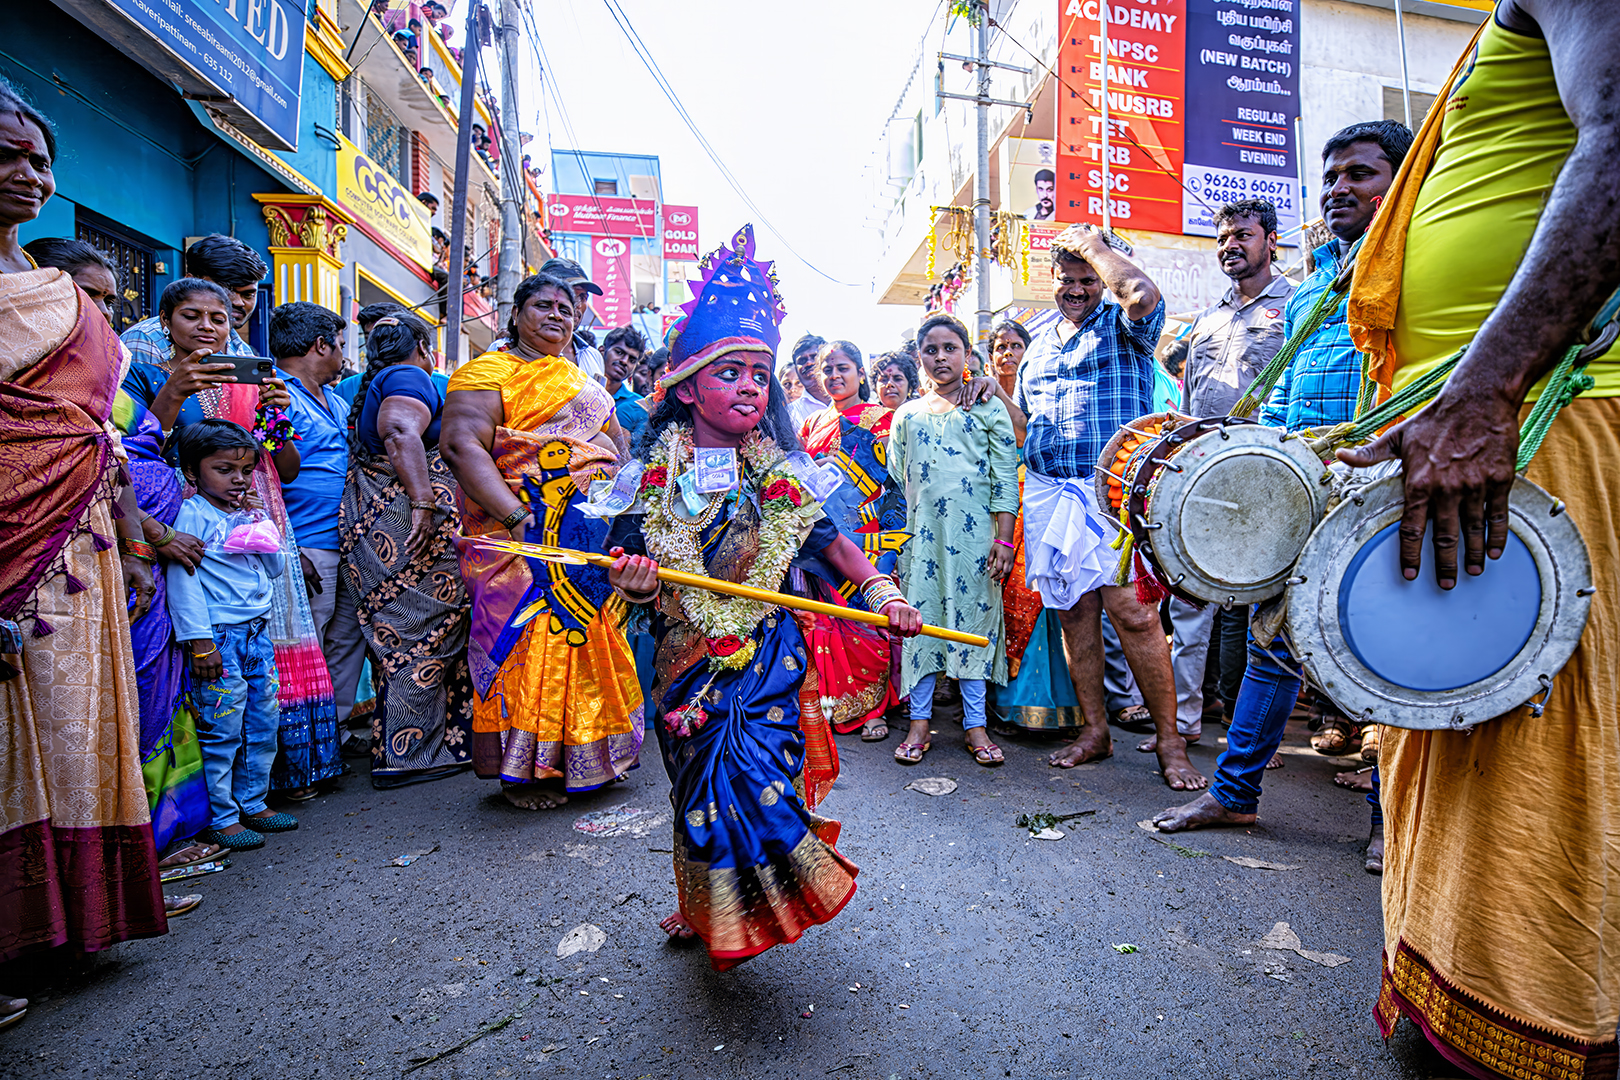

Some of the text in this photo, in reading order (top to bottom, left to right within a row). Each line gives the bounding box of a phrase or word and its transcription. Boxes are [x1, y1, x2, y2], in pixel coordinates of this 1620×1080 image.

[1065, 0, 1177, 33] ACADEMY
[1216, 9, 1293, 34] புதிய பயிற்சி
[1088, 34, 1159, 63] TNPSC
[1228, 34, 1293, 54] வகுப்புகள்
[184, 12, 288, 109] sreeabiraami2012@gmail.com
[203, 53, 218, 71] 635
[219, 65, 233, 84] 112
[1200, 49, 1292, 78] (NEW BATCH)
[1089, 61, 1149, 88] BANK
[1088, 88, 1174, 118] TNUSRB
[1088, 115, 1130, 138] TET
[1237, 107, 1286, 125] REGULAR
[1232, 127, 1286, 146] WEEK END
[1087, 142, 1131, 165] TRB
[1240, 149, 1286, 167] EVENING
[354, 155, 410, 229] CSC
[1204, 172, 1291, 195] 96263 60671
[1088, 196, 1131, 219] RRB
[665, 230, 697, 241] GOLD
[665, 243, 698, 254] LOAN
